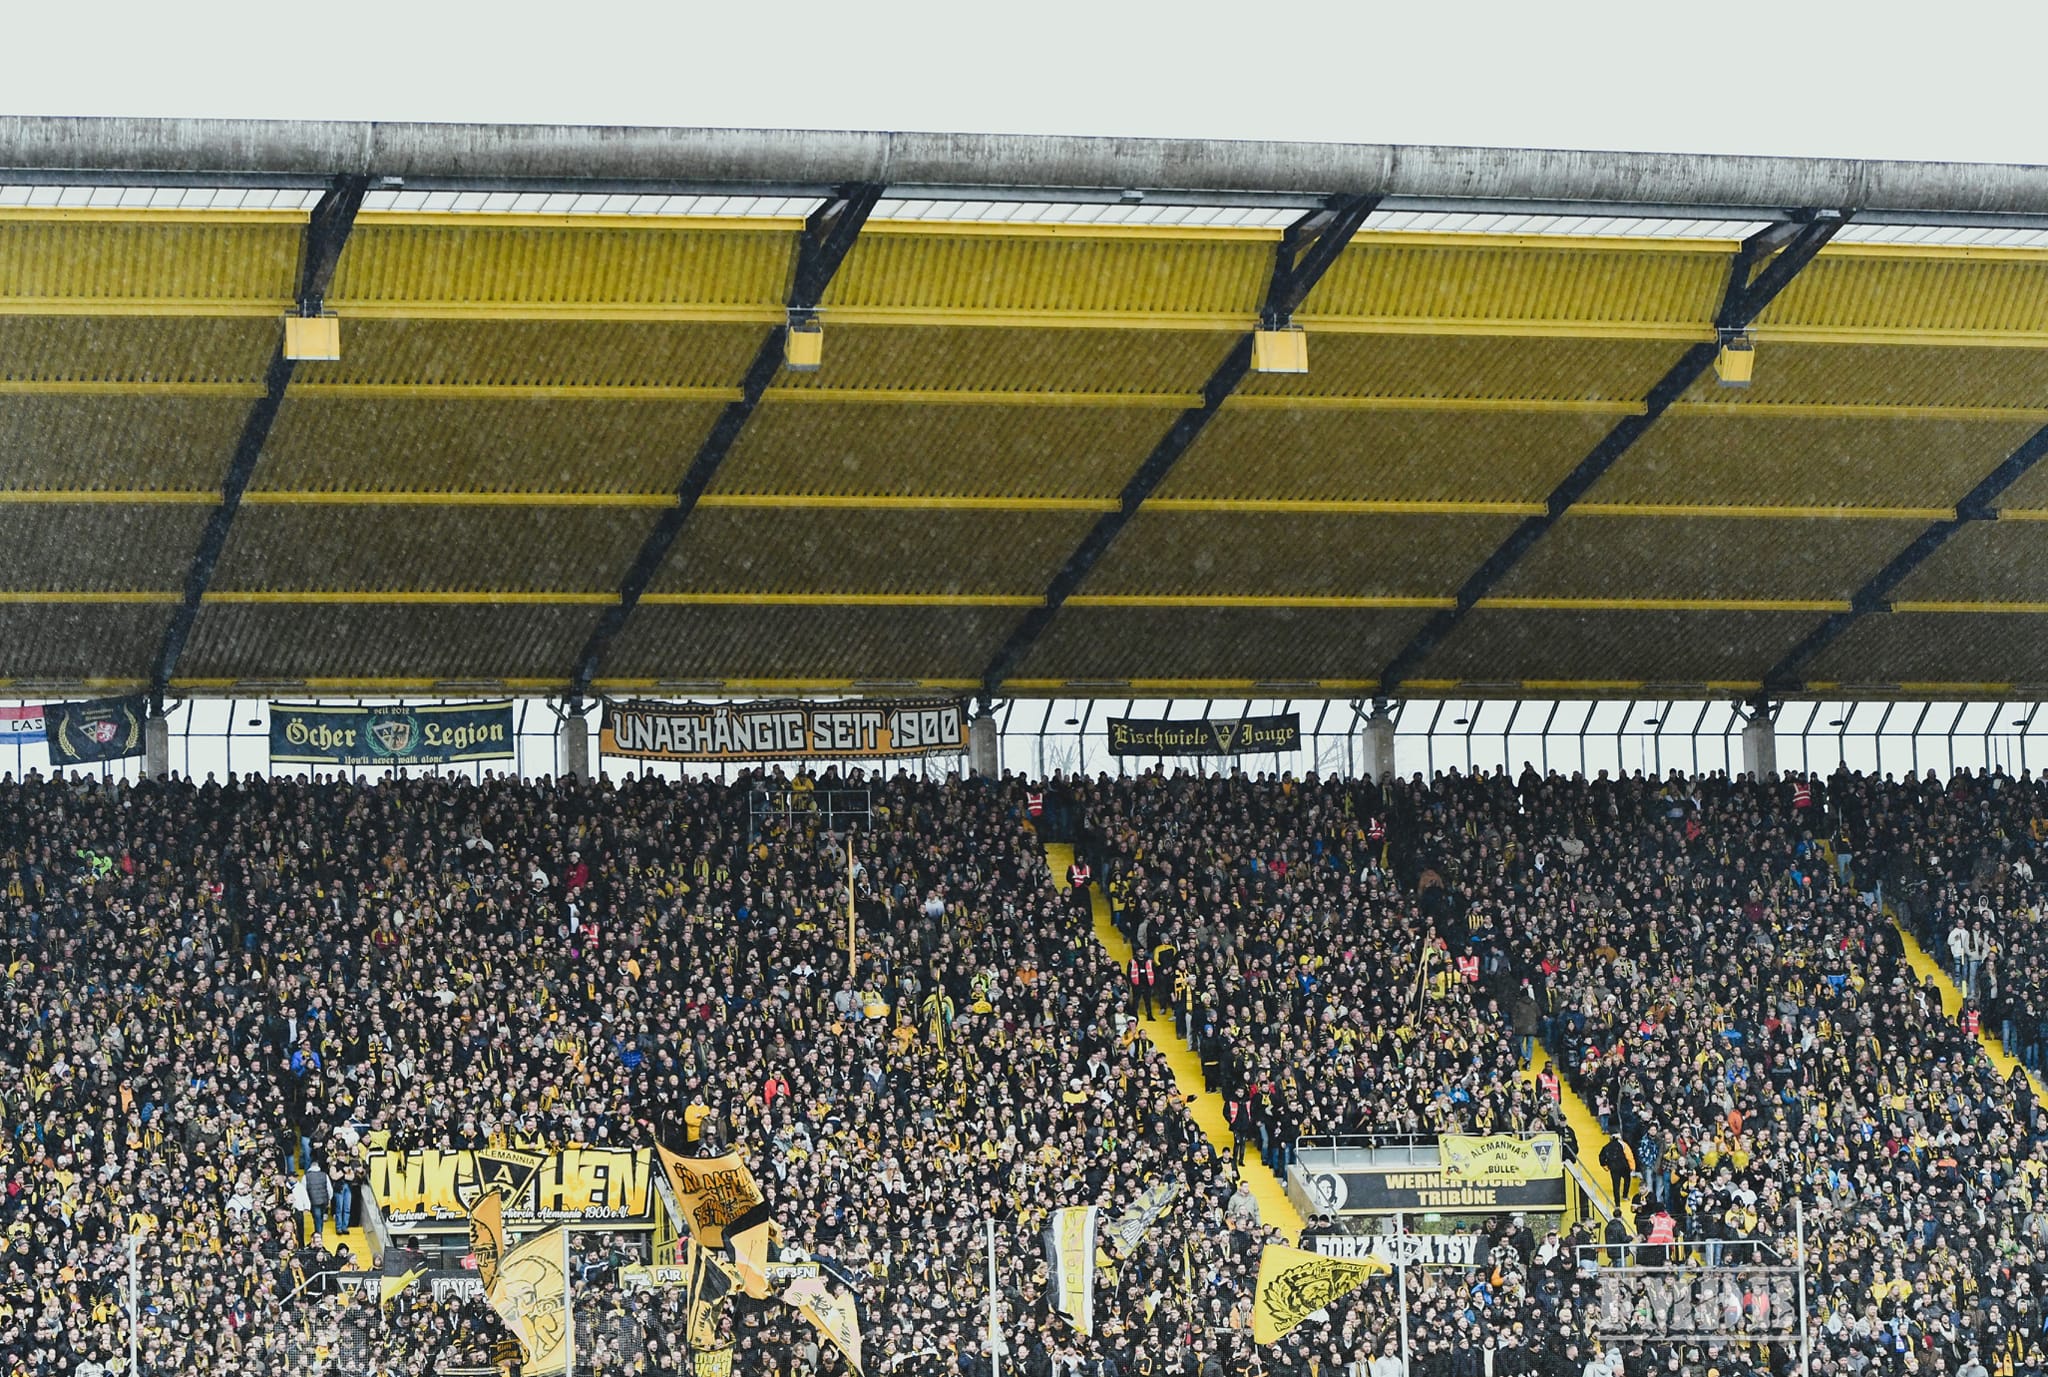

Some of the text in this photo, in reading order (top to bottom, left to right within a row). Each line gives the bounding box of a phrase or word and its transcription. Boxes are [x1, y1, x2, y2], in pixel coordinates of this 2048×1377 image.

[286, 717, 504, 751] Öcher Legion
[613, 708, 960, 751] UNABHÄNGIG SEIT 1900
[1112, 723, 1209, 750] Eischwiele
[1385, 1173, 1462, 1189] WERNER
[1417, 1188, 1497, 1206] TRIBÜNE
[584, 1206, 610, 1219] 1900
[1420, 1236, 1478, 1265] ATSV
[657, 1268, 682, 1282] FÜR
